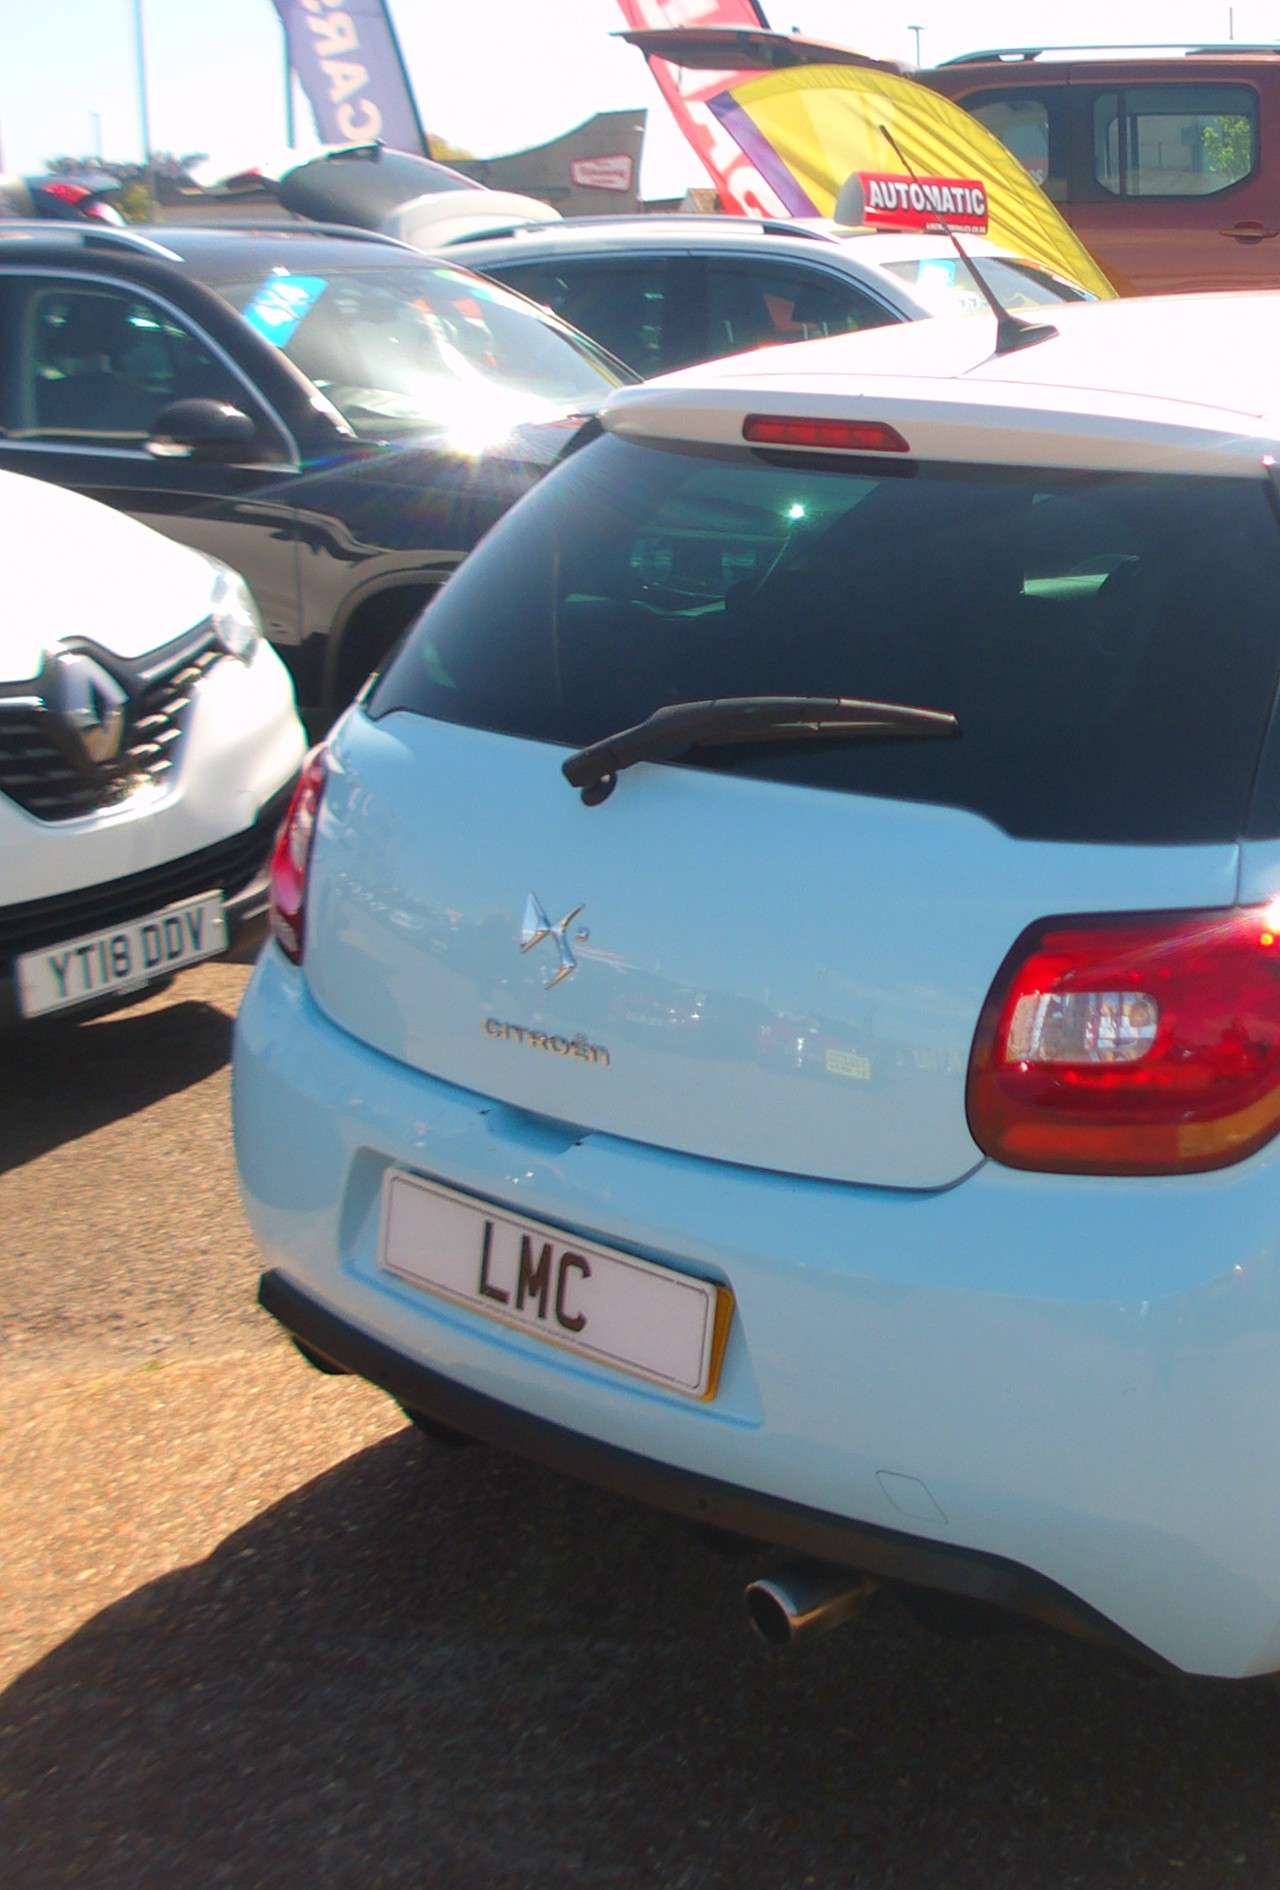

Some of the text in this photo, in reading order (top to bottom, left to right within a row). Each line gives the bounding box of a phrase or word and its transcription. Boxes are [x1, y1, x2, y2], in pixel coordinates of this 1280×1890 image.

[302, 0, 382, 142] CAR
[869, 180, 986, 216] AUTOMATIC
[48, 908, 205, 998] YT18 DDV
[479, 1220, 592, 1332] LMC
